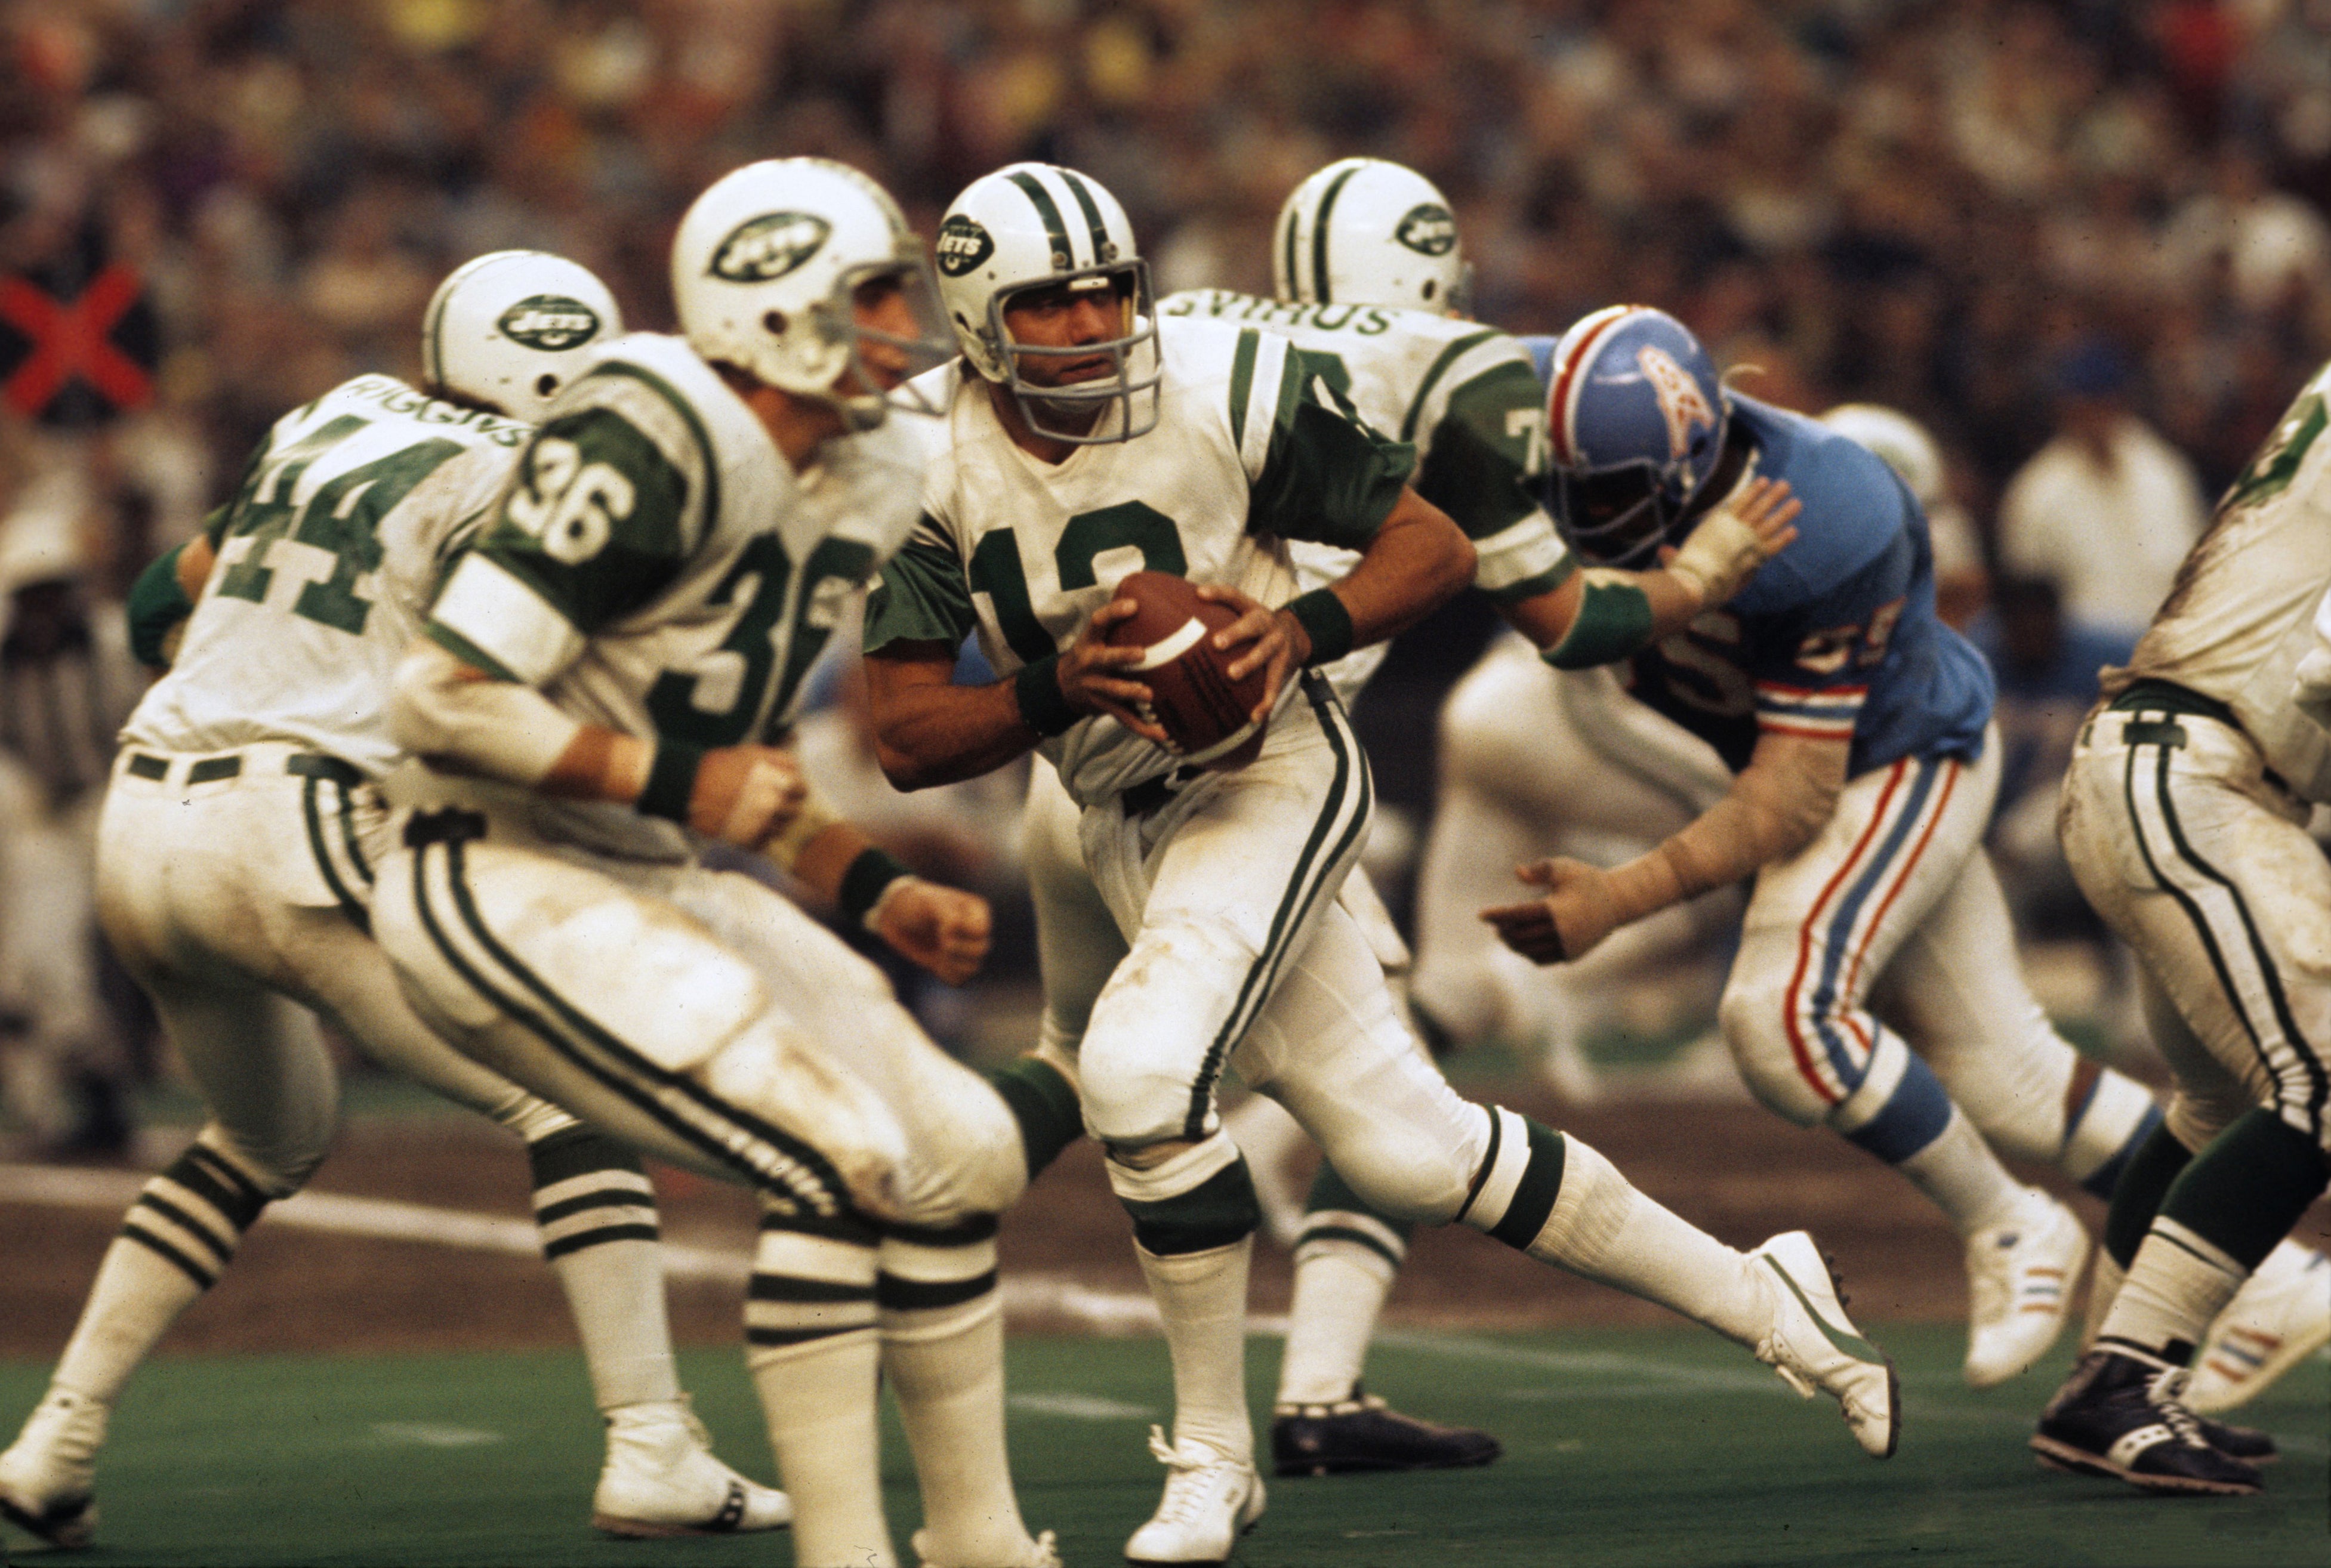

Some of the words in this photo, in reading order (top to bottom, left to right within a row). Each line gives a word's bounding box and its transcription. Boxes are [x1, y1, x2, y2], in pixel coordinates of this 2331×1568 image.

[936, 231, 982, 255] JETS
[217, 414, 470, 637] 44
[507, 436, 636, 566] 36
